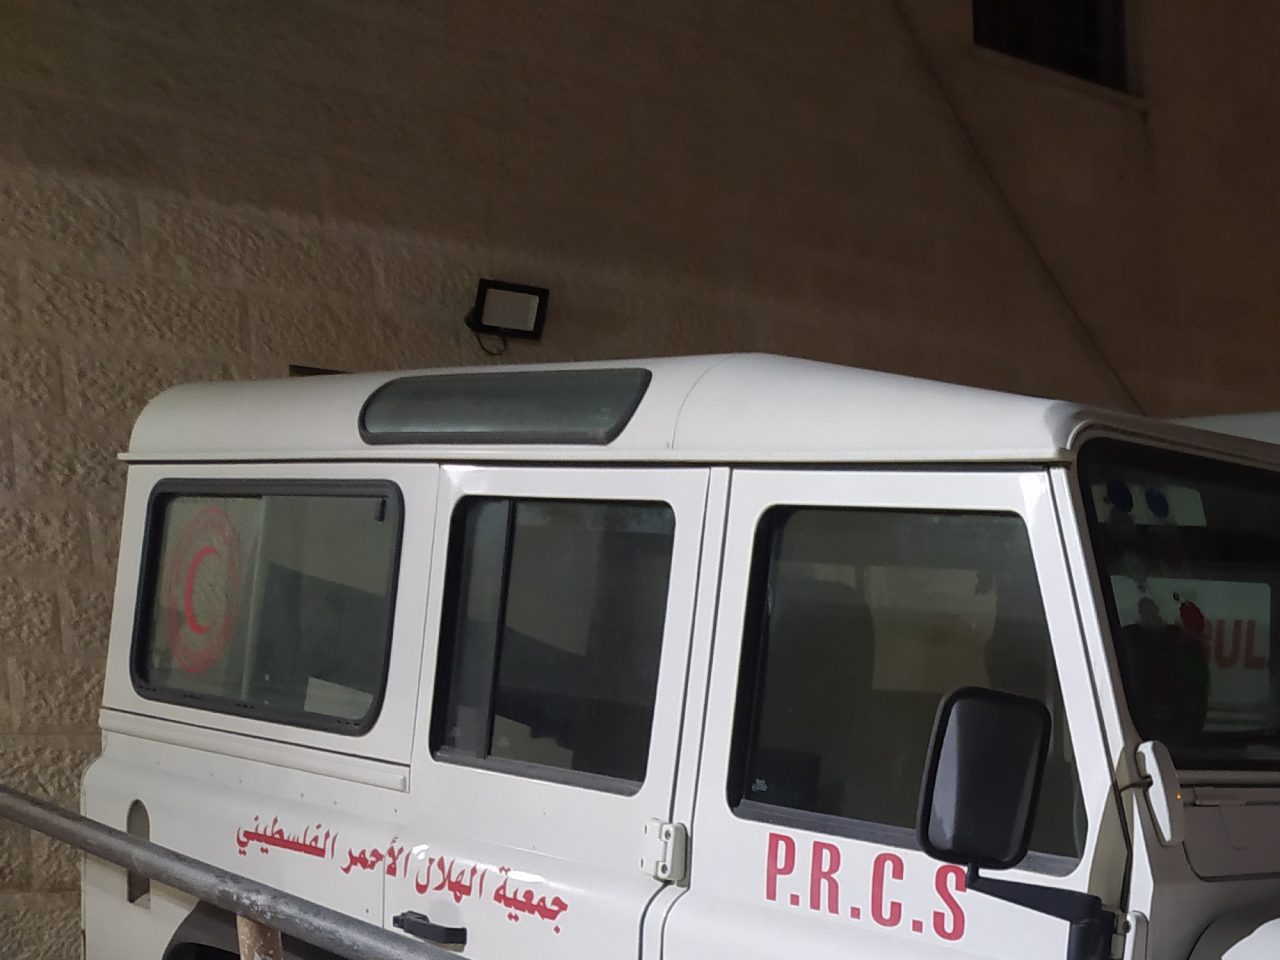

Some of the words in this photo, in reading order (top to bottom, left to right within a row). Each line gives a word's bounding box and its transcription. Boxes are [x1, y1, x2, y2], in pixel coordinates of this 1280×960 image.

[236, 814, 338, 860] الفلسطيني
[340, 836, 410, 877] الأحمر
[414, 856, 487, 903] الهلال
[493, 866, 569, 934] جمعية
[766, 832, 967, 941] P.R.C.S
